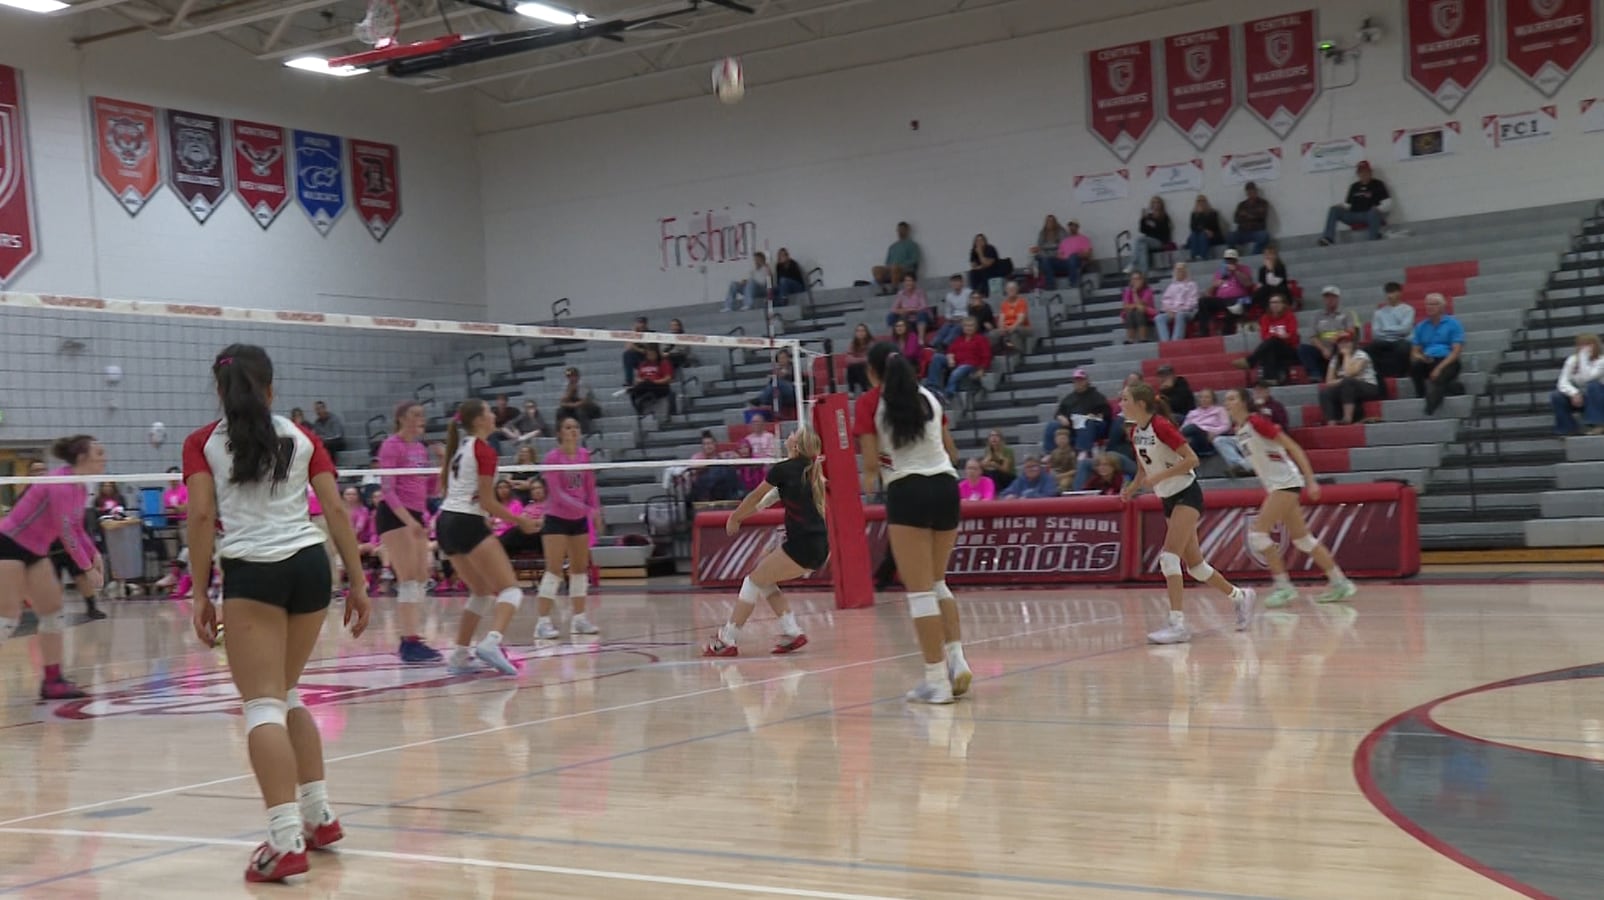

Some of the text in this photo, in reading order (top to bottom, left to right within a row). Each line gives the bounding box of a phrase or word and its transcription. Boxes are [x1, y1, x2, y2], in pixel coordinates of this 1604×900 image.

[1254, 16, 1301, 32] CENTRAL
[1515, 14, 1584, 35] WARRIORS
[1173, 30, 1221, 47] CENTRAL
[1416, 34, 1481, 54] WARRIORS
[1098, 46, 1143, 61] CENTRAL
[1254, 65, 1308, 83] WARRIORS
[1173, 78, 1227, 96] WARRIORS
[1098, 92, 1148, 109] WARRIORS
[1501, 120, 1539, 138] FCI
[1139, 448, 1152, 464] 5
[992, 517, 1037, 529] HIGH
[1045, 517, 1120, 533] SCHOOL
[956, 531, 1079, 545] OME OF THE
[945, 542, 1121, 573] ARRIORS
